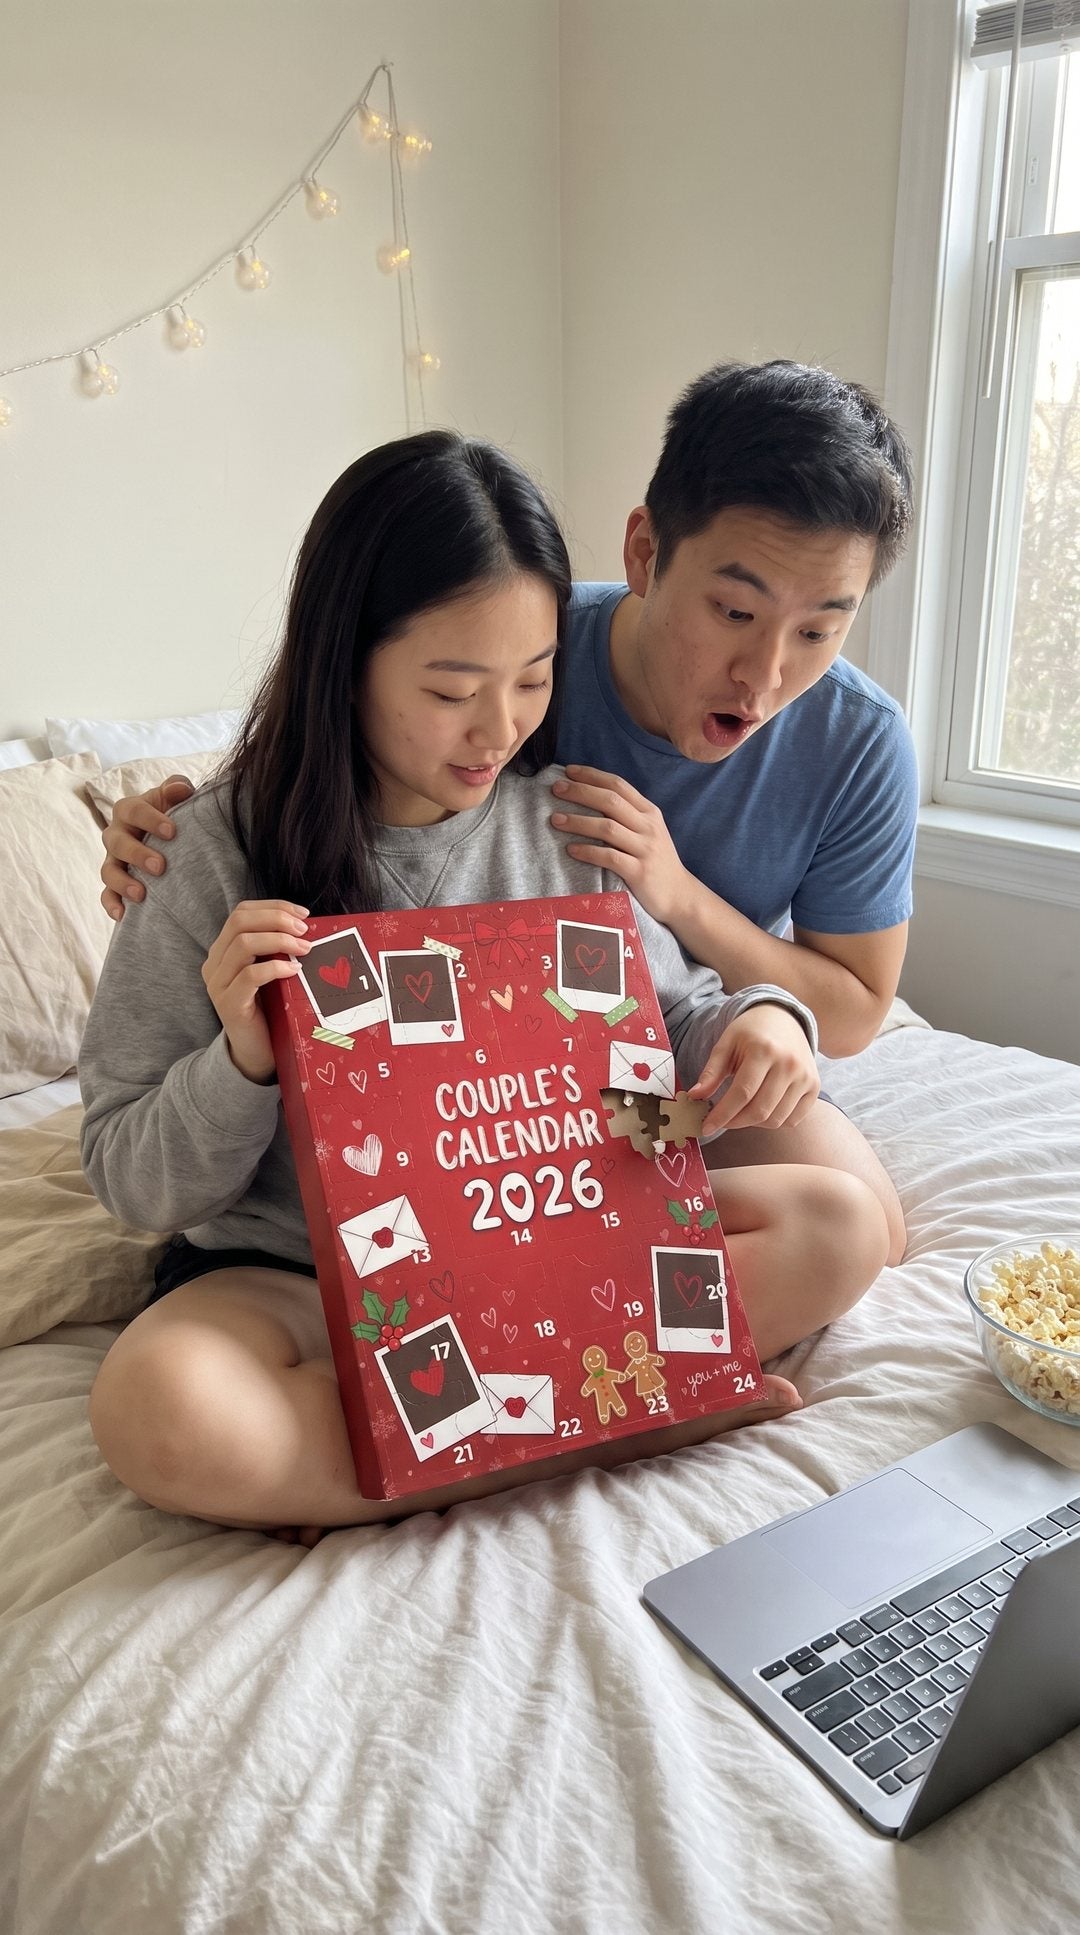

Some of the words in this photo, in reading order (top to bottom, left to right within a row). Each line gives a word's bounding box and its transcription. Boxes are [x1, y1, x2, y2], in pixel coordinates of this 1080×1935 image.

[540, 955, 553, 970] 3
[623, 946, 634, 960] 4
[455, 963, 468, 979] 2
[358, 974, 369, 991] 1
[645, 1027, 657, 1042] 8
[562, 1037, 573, 1053] 7
[475, 1048, 487, 1064] 6
[377, 1062, 390, 1078] 5
[435, 1063, 582, 1122] COUPLE'S
[435, 1108, 605, 1171] CALENDAR
[396, 1151, 409, 1167] 9
[462, 1157, 605, 1232] 2026
[684, 1196, 704, 1213] 16
[600, 1211, 621, 1229] 15
[510, 1227, 533, 1246] 14
[411, 1246, 432, 1265] 13
[705, 1282, 728, 1301] 20
[623, 1300, 644, 1318] 19
[533, 1319, 557, 1338] 18
[430, 1341, 452, 1362] 17
[686, 1371, 714, 1397] you
[722, 1359, 743, 1373] me
[732, 1373, 757, 1394] 24
[646, 1394, 670, 1416] 23
[558, 1417, 583, 1438] 22
[453, 1443, 474, 1465] 21
